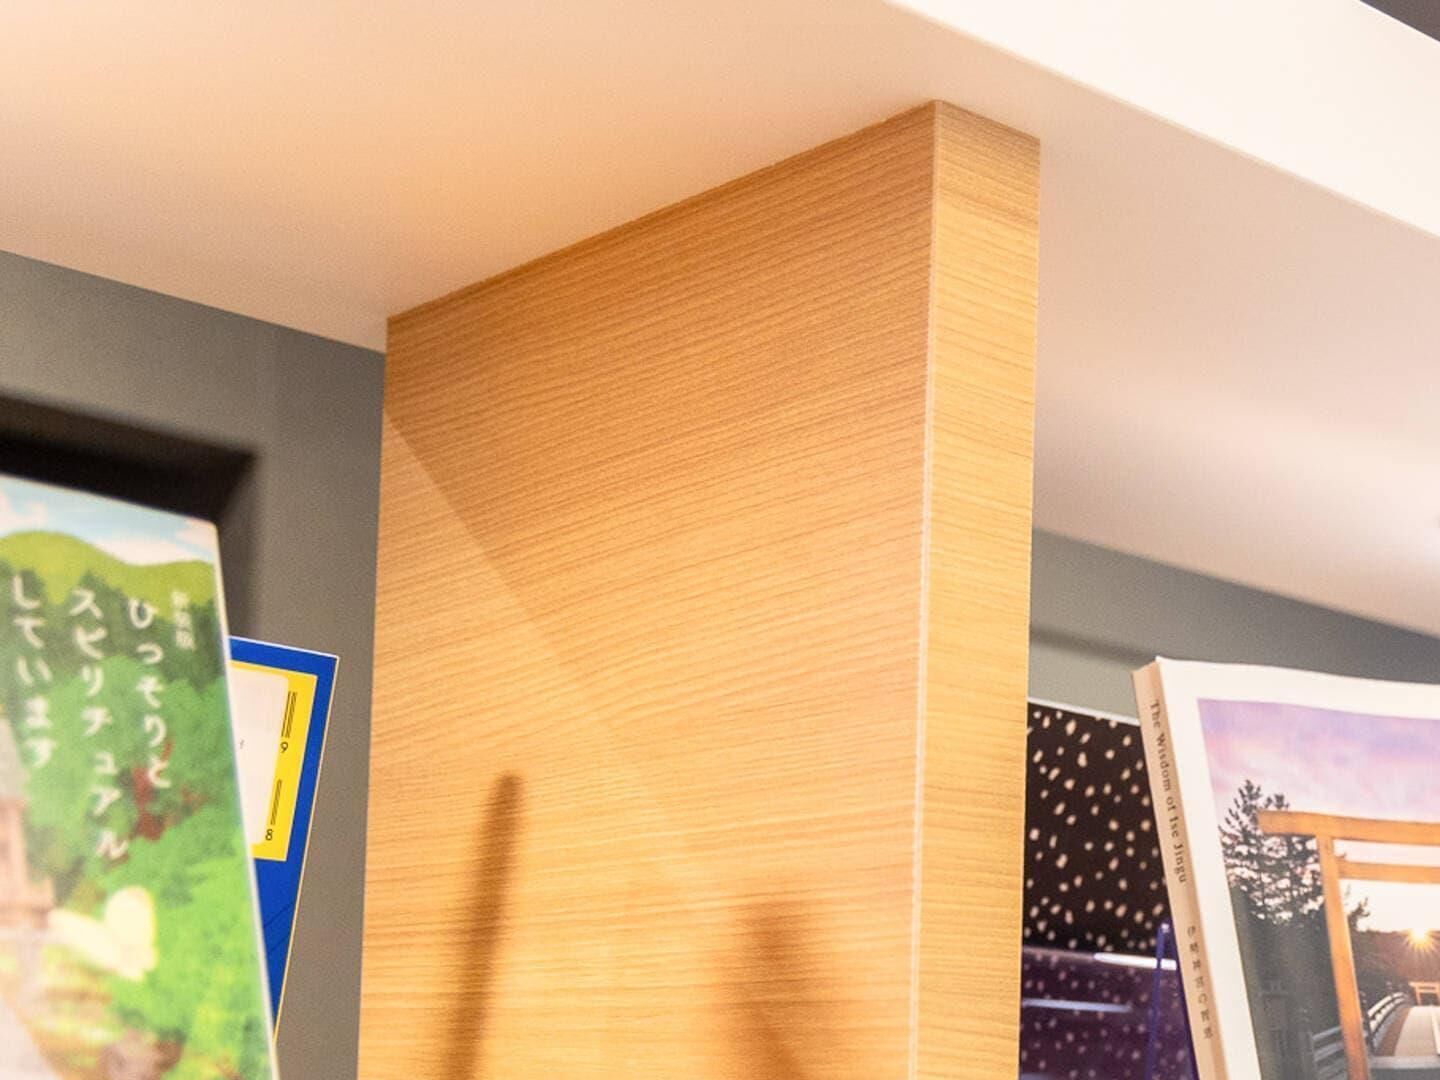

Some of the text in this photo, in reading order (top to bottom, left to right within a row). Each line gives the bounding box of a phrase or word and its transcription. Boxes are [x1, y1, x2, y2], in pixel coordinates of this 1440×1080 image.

[12, 574, 56, 769] しています
[69, 587, 129, 860] スピリチュアル
[127, 597, 171, 788] ひっそりと
[280, 741, 289, 754] 9
[265, 828, 273, 841] 8
[1149, 700, 1187, 884] The Wisdom of Ise Jingu
